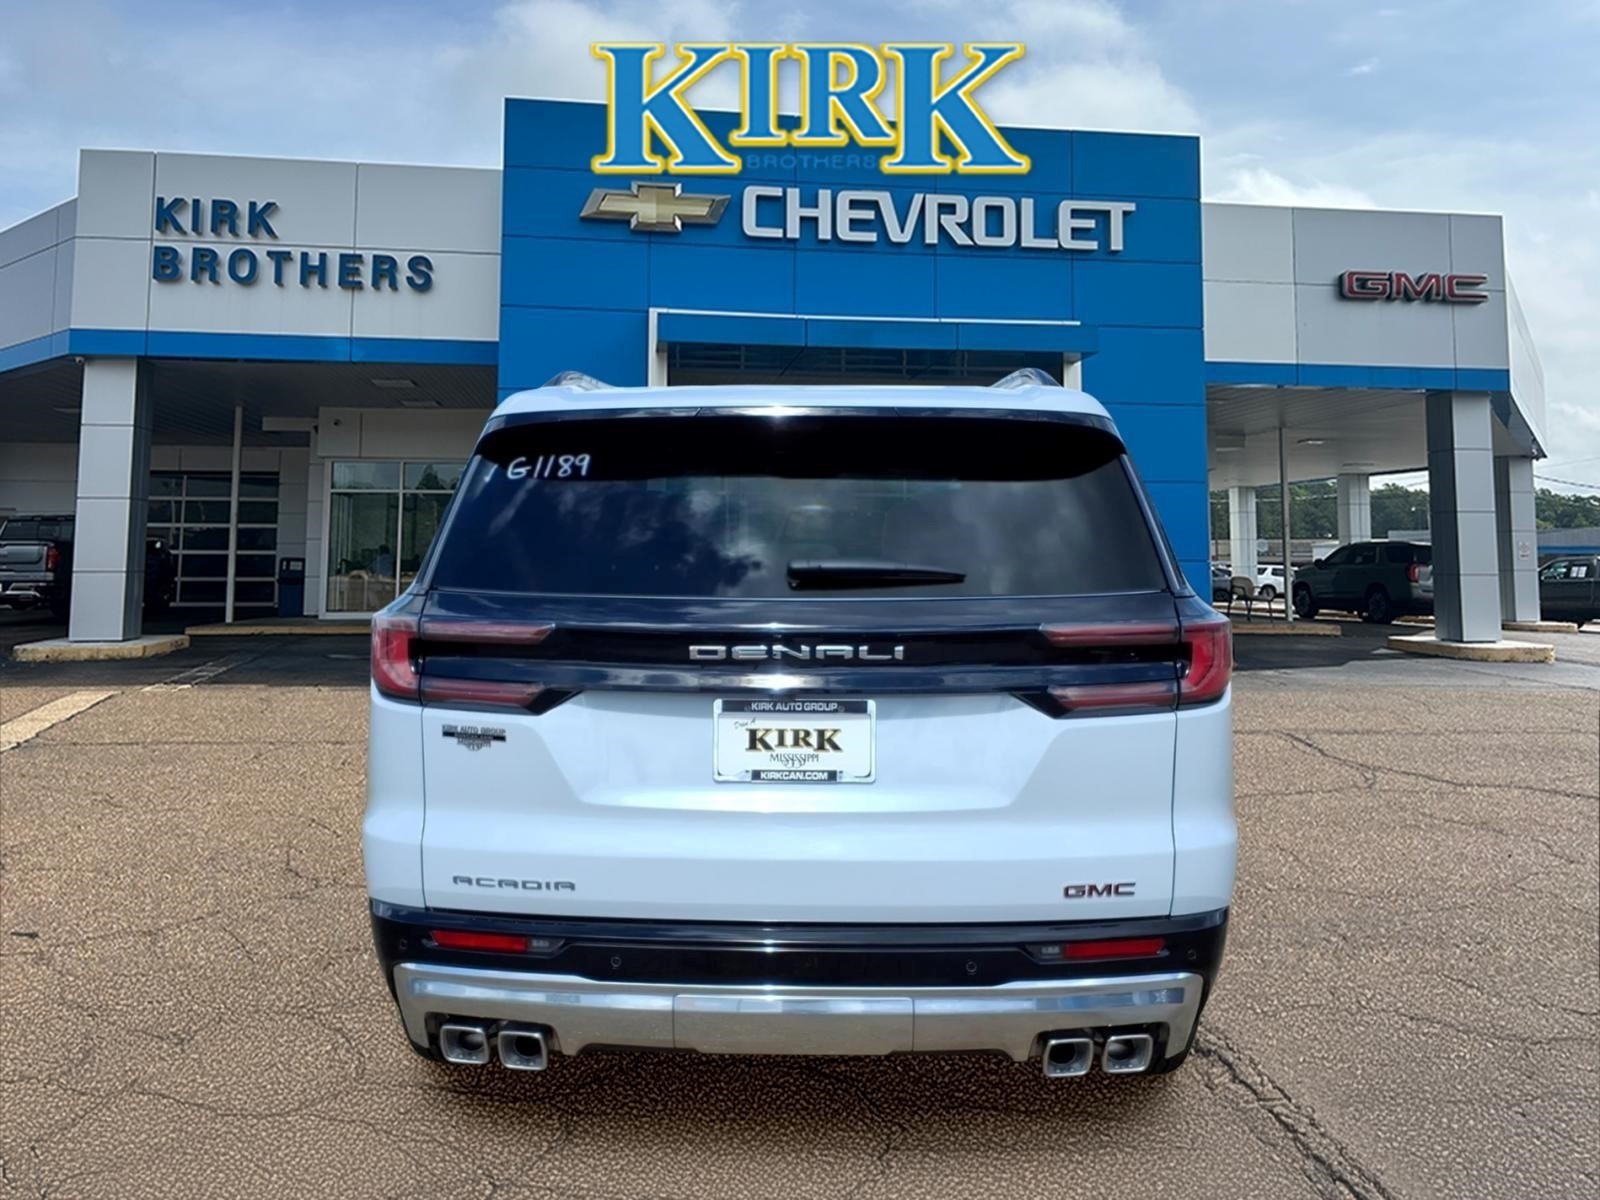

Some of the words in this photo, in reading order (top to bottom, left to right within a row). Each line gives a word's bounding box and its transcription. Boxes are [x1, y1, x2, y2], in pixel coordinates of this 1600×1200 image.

[155, 196, 279, 240] KIRK
[741, 184, 1137, 252] CHEVROLET
[152, 245, 434, 293] BROTHERS
[1339, 270, 1489, 304] GMC
[688, 645, 904, 661] DENALI
[751, 702, 774, 711] KIRK
[775, 702, 803, 711] AUTO
[804, 702, 838, 712] GROUP
[745, 728, 844, 752] KIRK
[760, 771, 829, 780] KIRKCAN.COM
[452, 875, 576, 891] ACADIA
[1063, 882, 1136, 898] GMC
